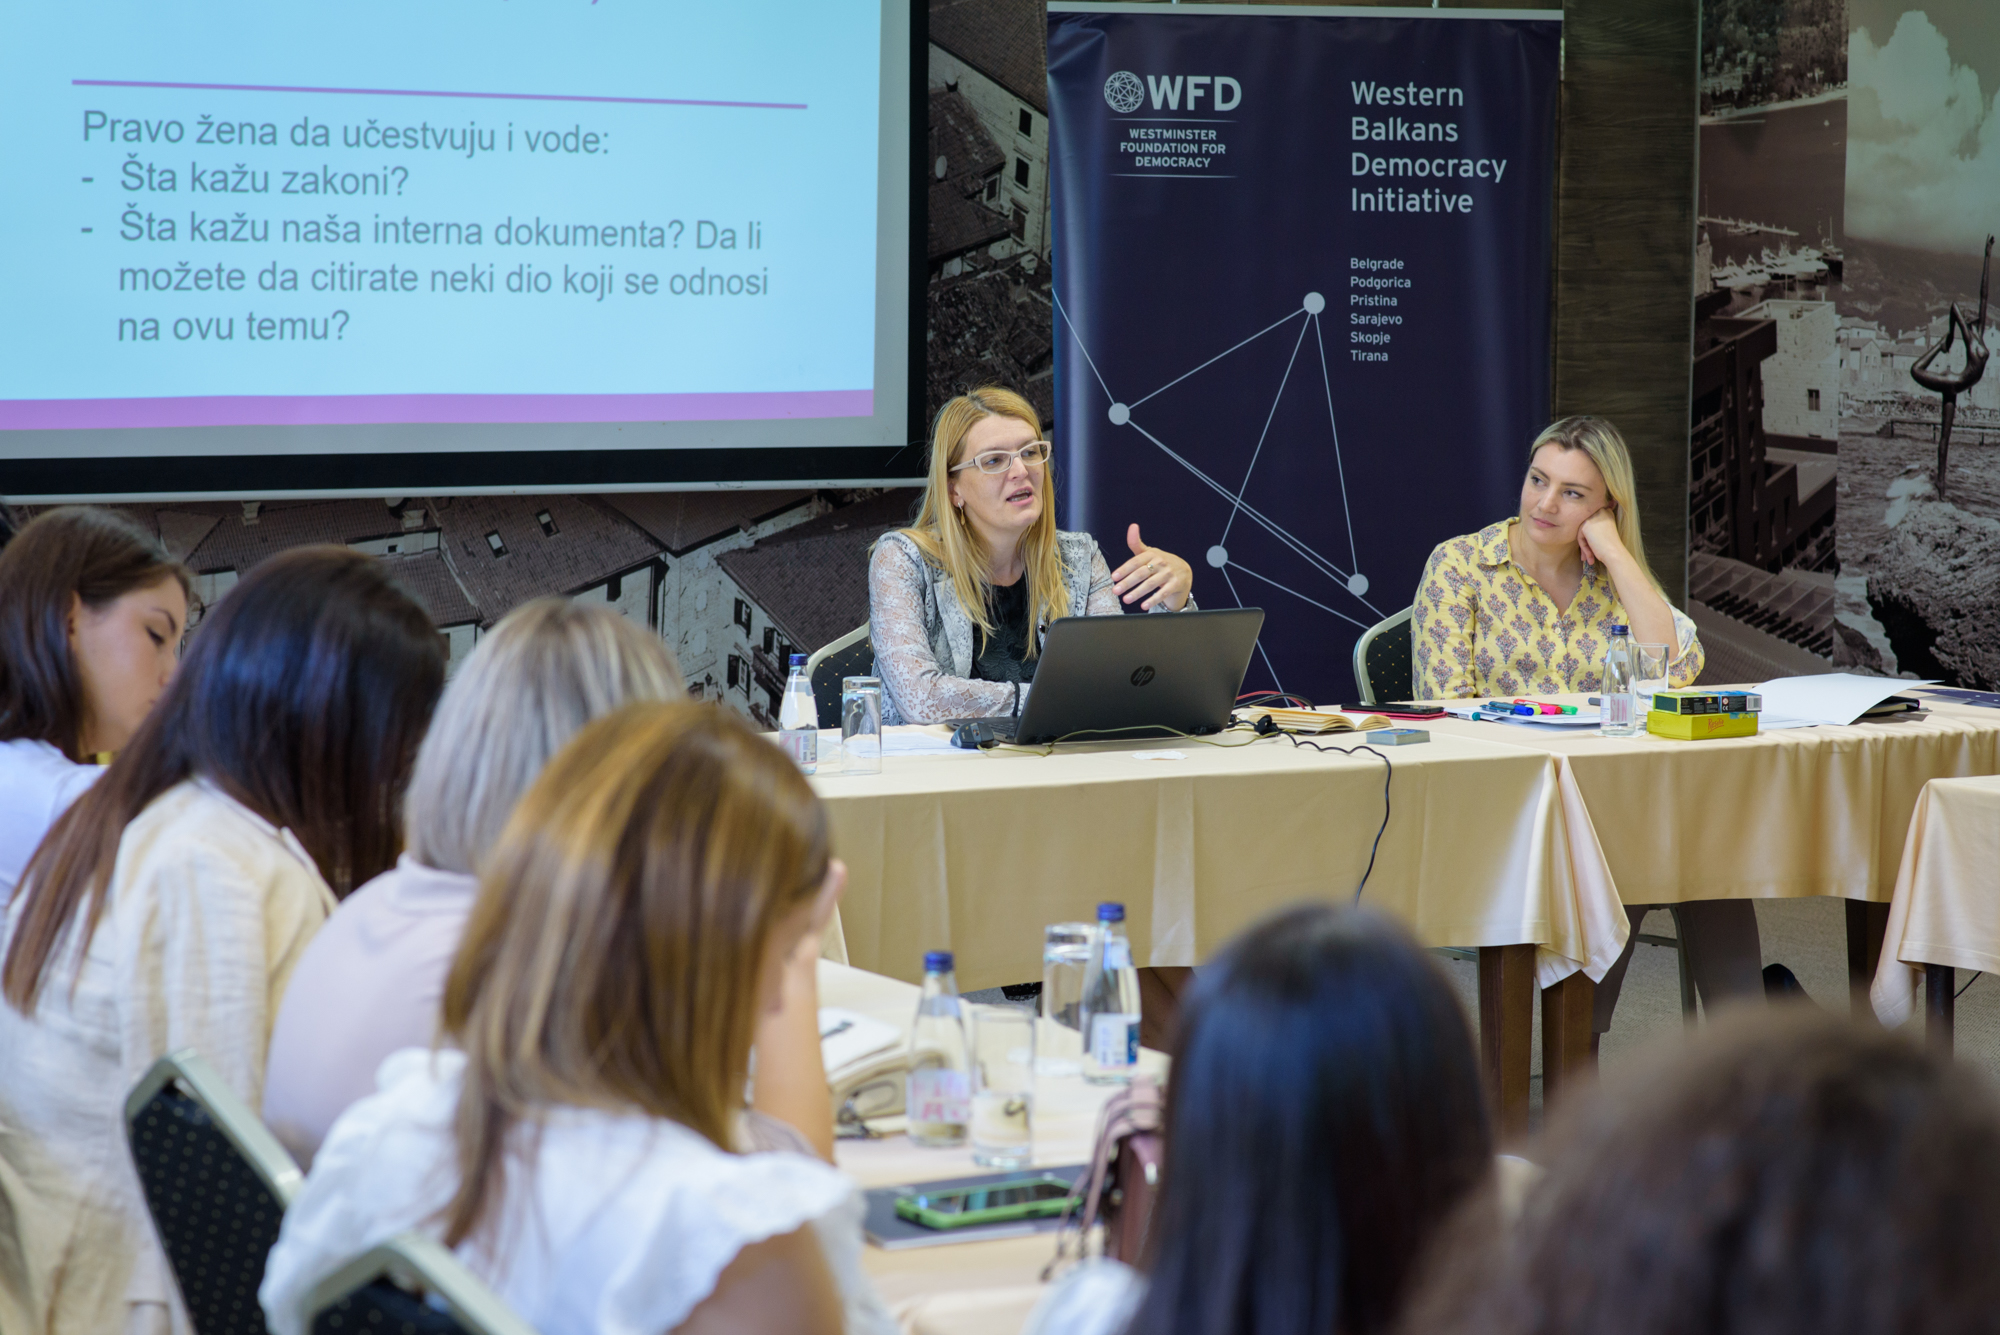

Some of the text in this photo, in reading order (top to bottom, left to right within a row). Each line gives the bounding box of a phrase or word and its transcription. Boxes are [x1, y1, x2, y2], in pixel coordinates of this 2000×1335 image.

[1146, 74, 1242, 112] WFD
[1350, 81, 1464, 107] Western
[83, 110, 609, 158] Pravo žena da učestvuju i vode:
[1128, 128, 1217, 141] WESTMINSTER
[1351, 116, 1459, 142] Balkans
[1120, 142, 1226, 155] FOUNDATION FOR
[1134, 156, 1211, 168] DEMOCRACY
[1351, 152, 1507, 183] Democracy
[120, 153, 177, 192] Šta
[190, 161, 269, 194] kažu
[281, 165, 409, 196] zakoni?
[1351, 187, 1474, 213] Initiative
[119, 202, 177, 241] Šta
[190, 211, 269, 243] kažu
[282, 214, 361, 244] naša
[373, 213, 483, 245] interna
[494, 216, 685, 249] dokumenta?
[696, 220, 737, 250] Da
[748, 221, 762, 250] li
[1350, 258, 1405, 272] Belgrade
[119, 261, 768, 303] možete da citirate neki dio koji se odnosi
[1350, 276, 1412, 290] Podgorica
[1350, 294, 1398, 307] Pristina
[118, 310, 350, 342] na ovu temu?
[1350, 312, 1403, 327] Sarajevo
[1350, 331, 1391, 346] Skopje
[1350, 350, 1389, 362] Tirana
[1131, 666, 1155, 687] hp
